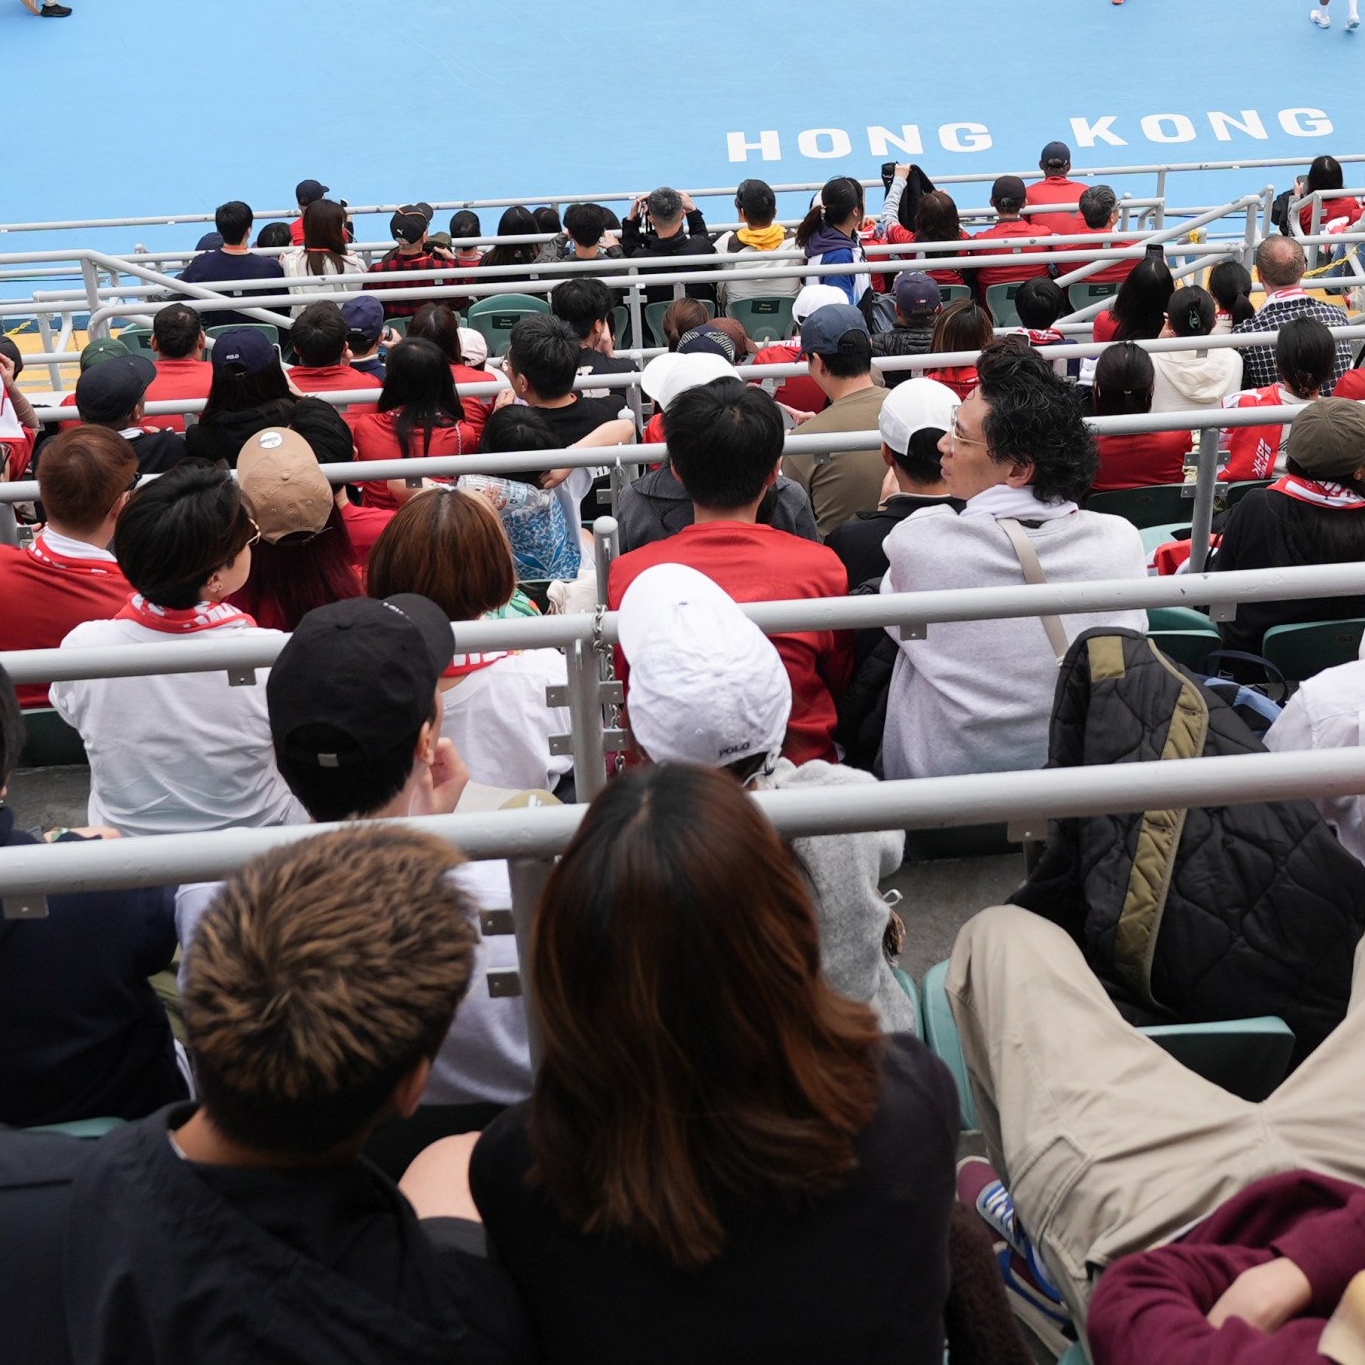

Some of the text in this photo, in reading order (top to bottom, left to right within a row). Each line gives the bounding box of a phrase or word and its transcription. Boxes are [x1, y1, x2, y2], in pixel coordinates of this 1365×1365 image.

[727, 107, 1335, 163] HONG KONG
[718, 741, 751, 757] POLO
